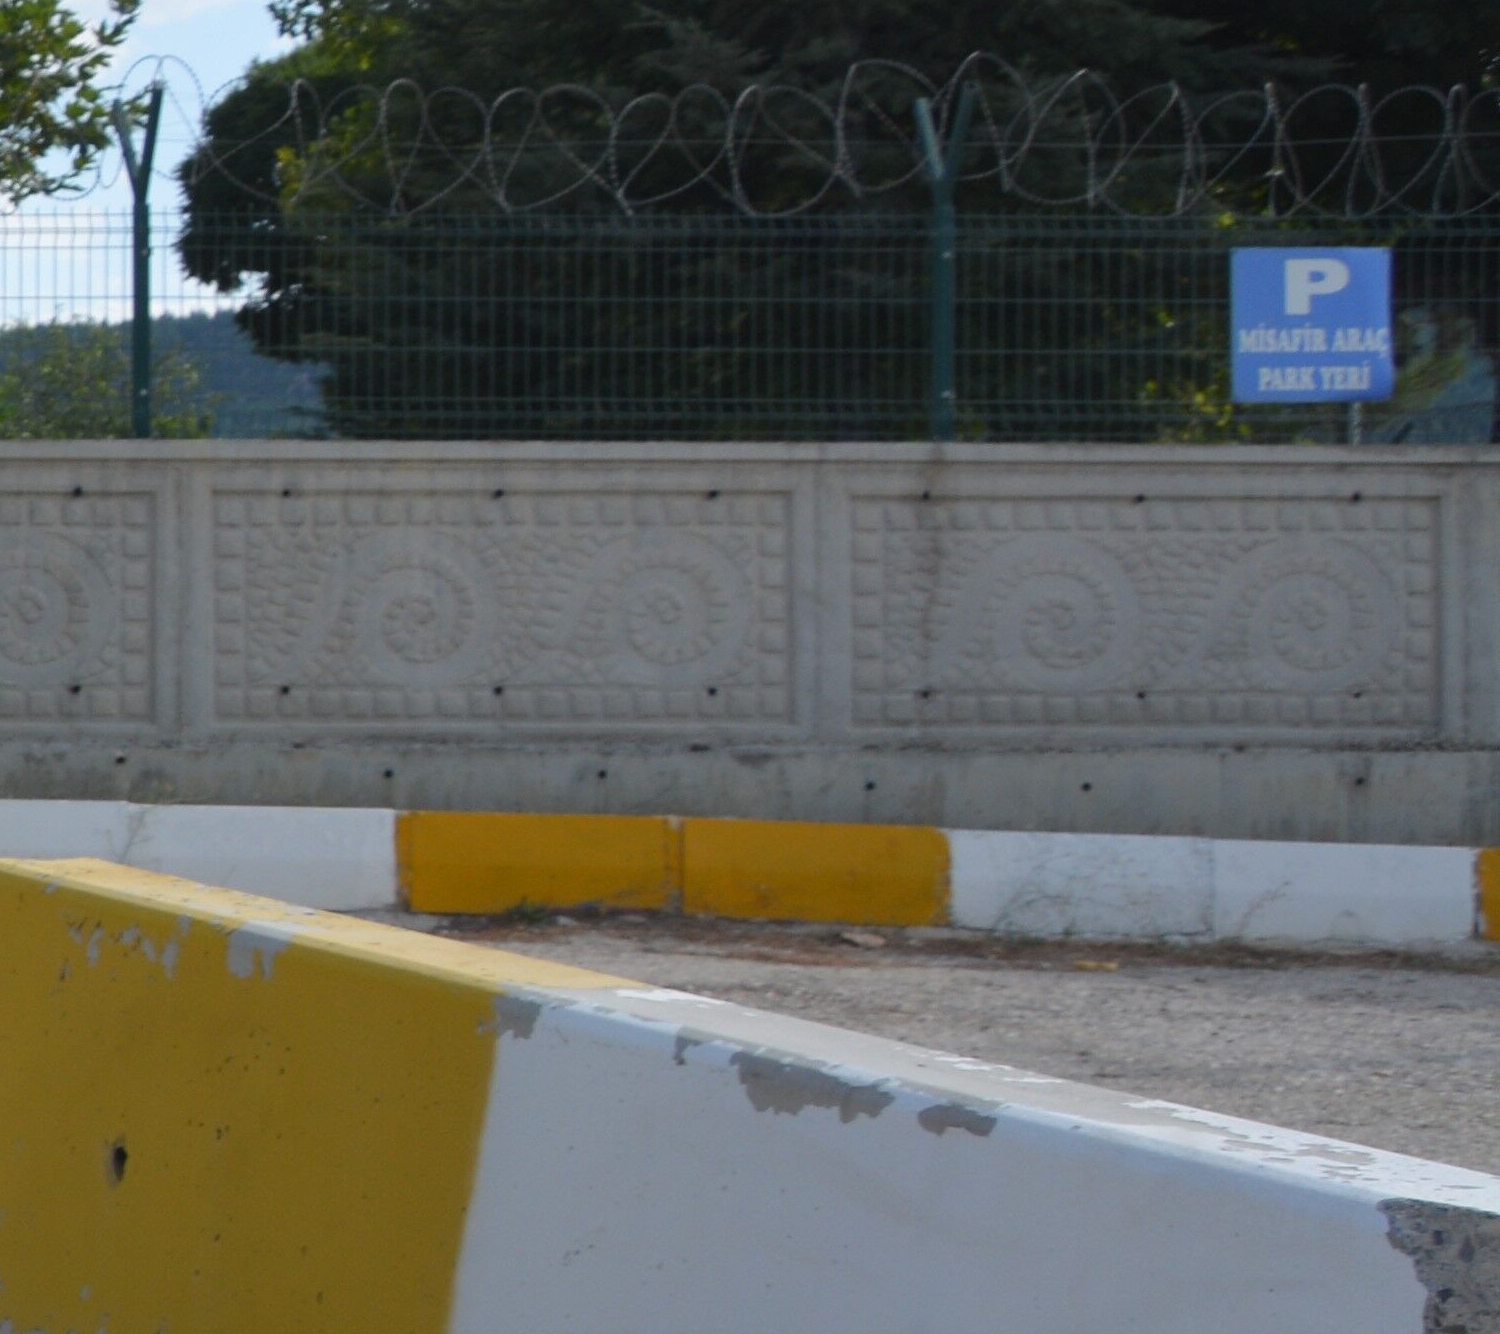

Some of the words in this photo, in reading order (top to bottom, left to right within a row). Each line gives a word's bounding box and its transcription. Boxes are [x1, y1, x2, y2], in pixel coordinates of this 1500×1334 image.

[1285, 258, 1349, 315] P
[1331, 327, 1390, 359] ARAÇ
[1259, 366, 1316, 391] PARK
[1319, 359, 1372, 391] YERİ
